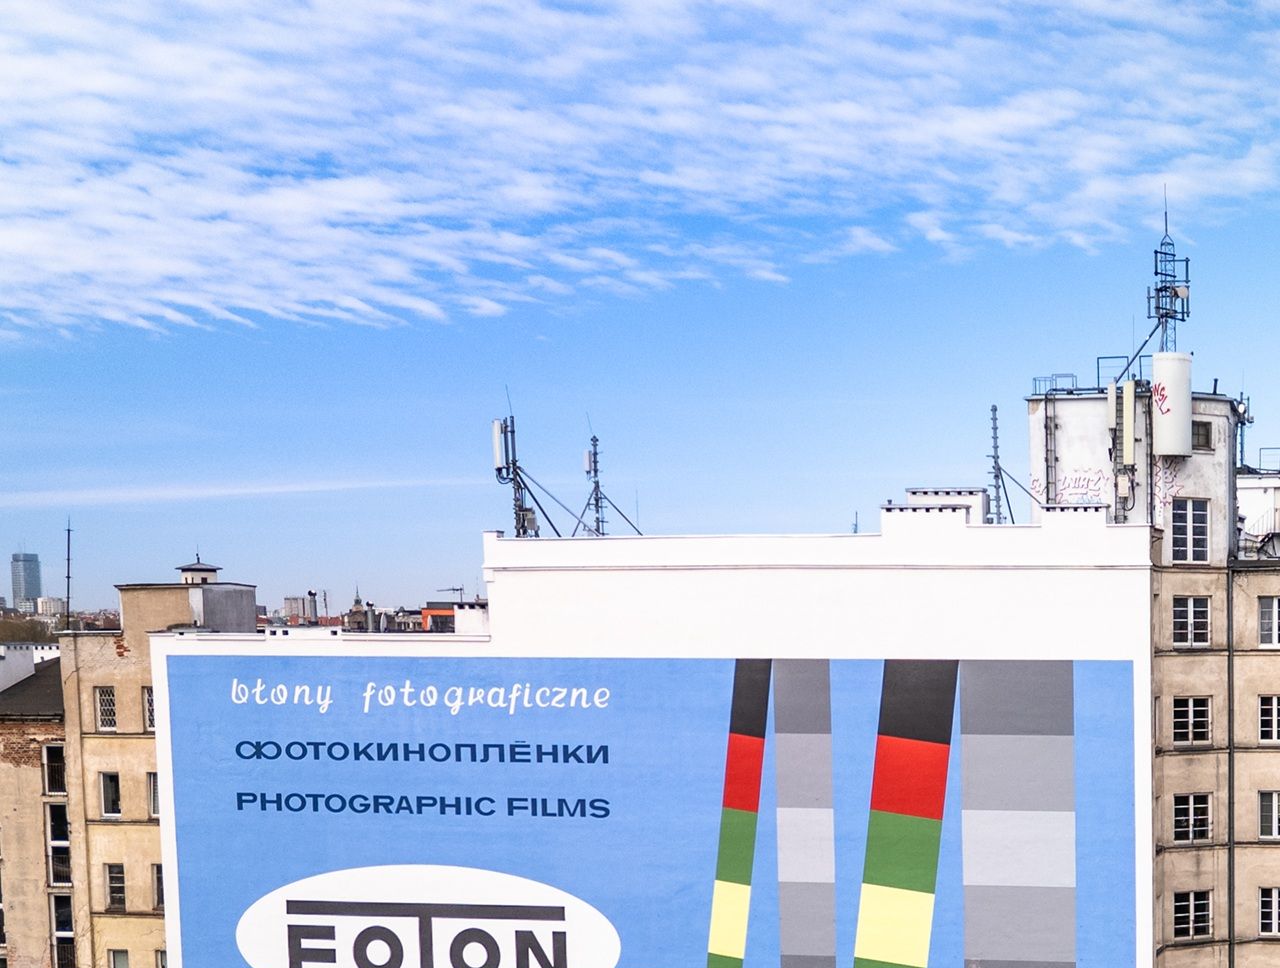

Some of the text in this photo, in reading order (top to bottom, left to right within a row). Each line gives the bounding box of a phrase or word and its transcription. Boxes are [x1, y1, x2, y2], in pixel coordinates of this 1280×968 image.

[363, 680, 610, 716] fotograficzne
[235, 740, 610, 764] ФОТОКИНОПЛЁНКИ
[236, 792, 611, 819] PHOTOGRAPHIC FILMS
